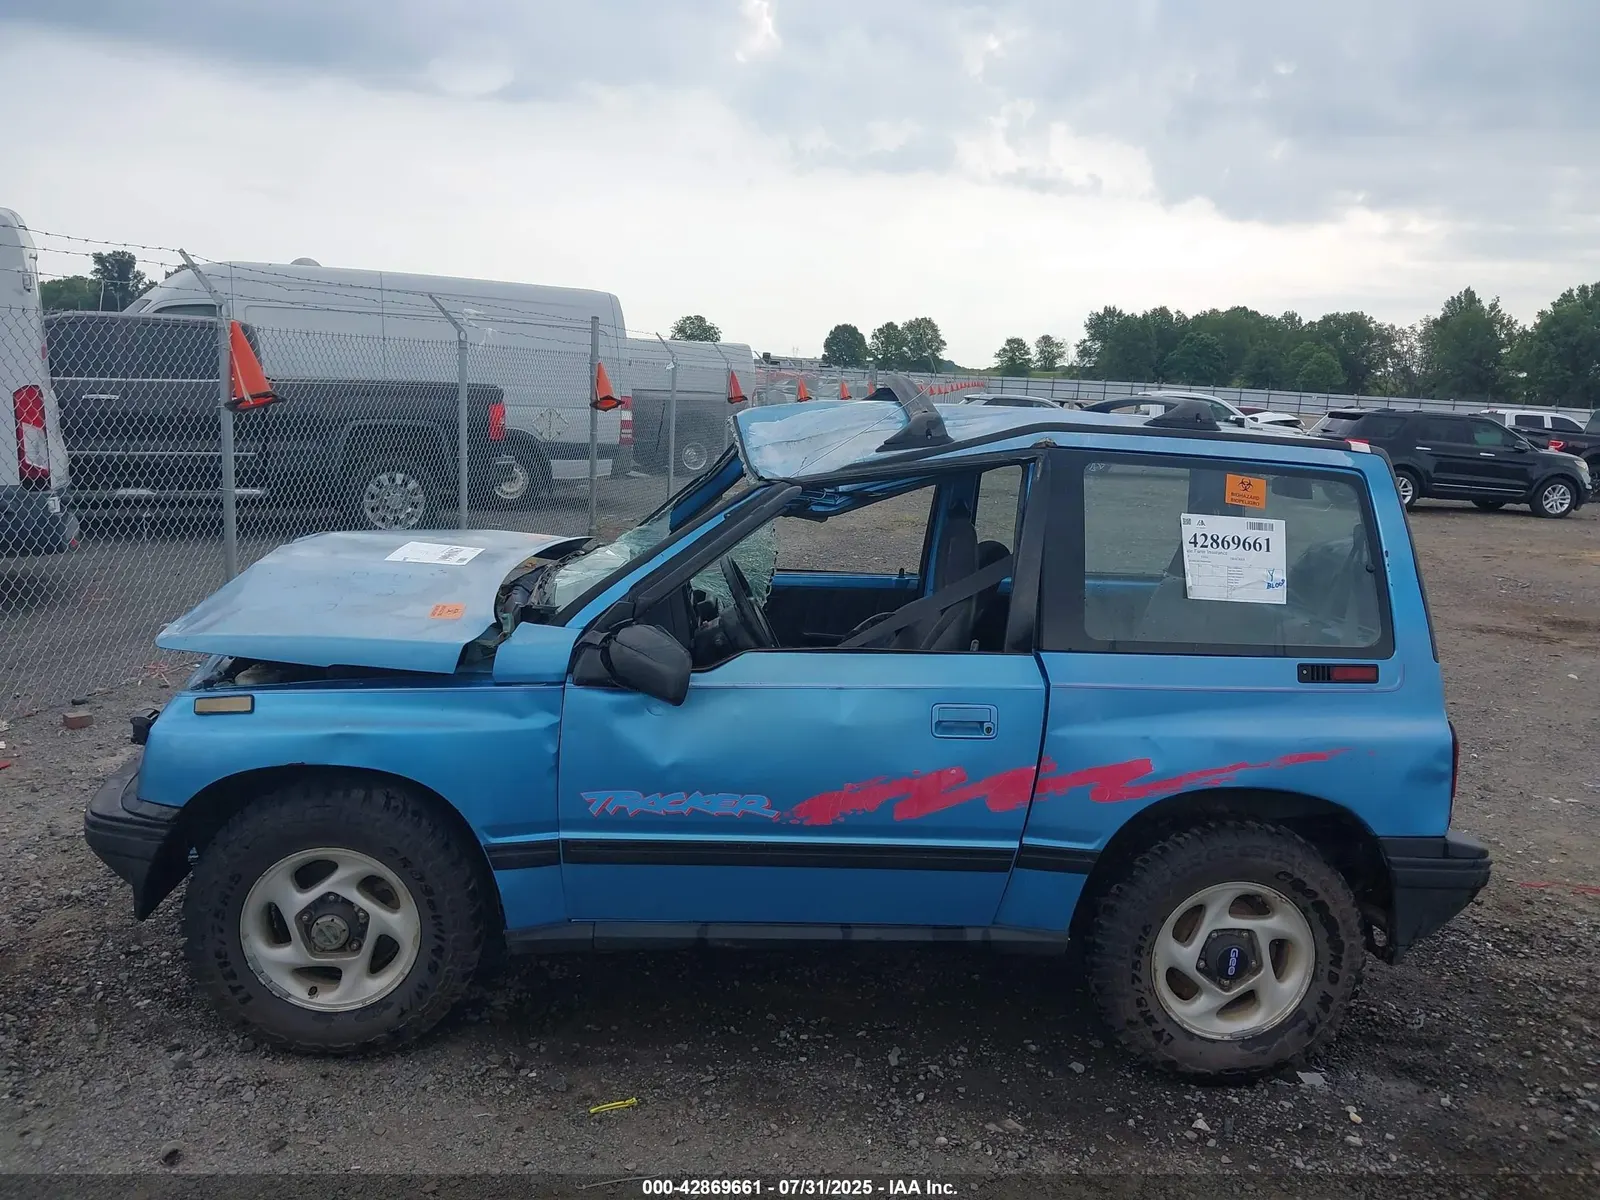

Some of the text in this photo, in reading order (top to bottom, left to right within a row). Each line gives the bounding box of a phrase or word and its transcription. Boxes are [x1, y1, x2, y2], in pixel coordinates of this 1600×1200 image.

[1231, 492, 1260, 500] BIOHAZARD
[1231, 498, 1260, 506] BIOPELIGRO
[1188, 533, 1272, 553] 42869661
[580, 790, 781, 820] TRACKER
